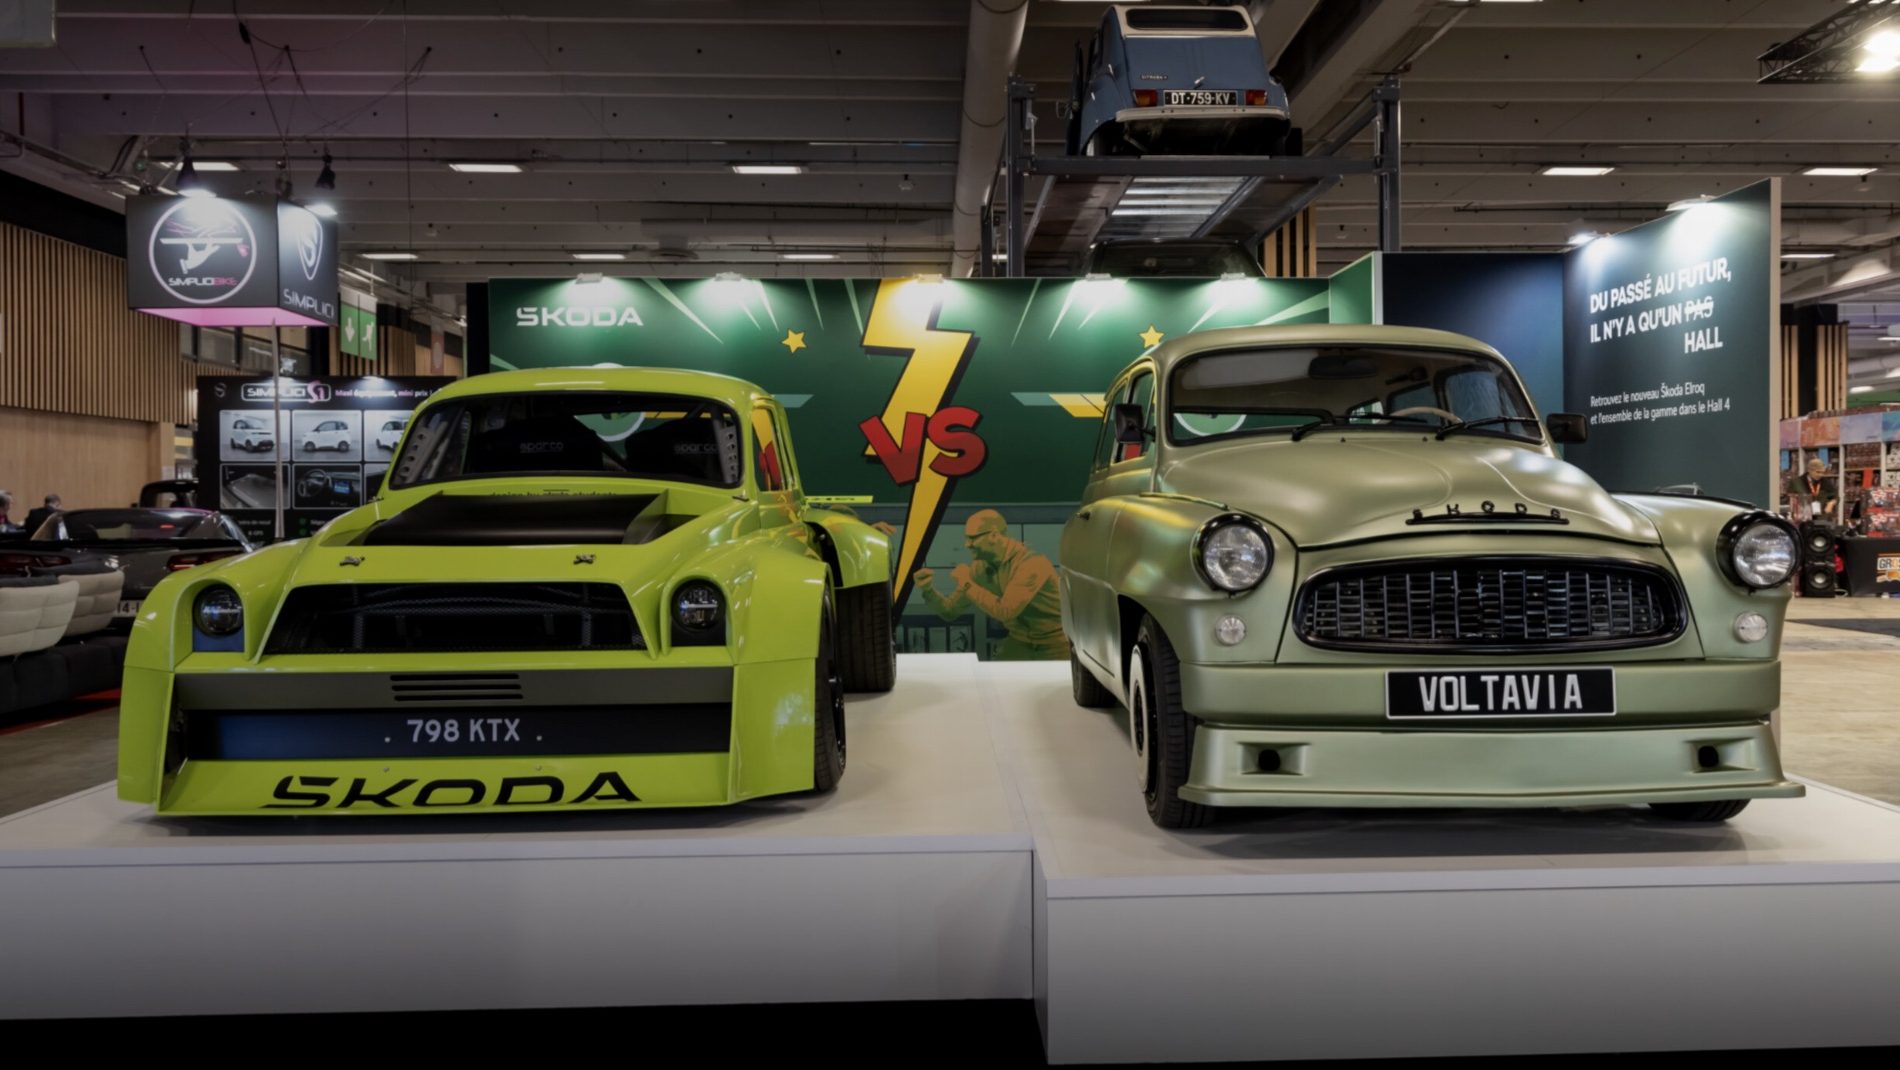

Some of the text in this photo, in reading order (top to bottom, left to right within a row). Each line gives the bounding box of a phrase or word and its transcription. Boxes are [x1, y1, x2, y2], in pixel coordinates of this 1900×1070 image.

[1590, 257, 1732, 314] DU PASSÉ AU FUTUR,
[283, 288, 335, 319] SIMPLICI
[1590, 296, 1714, 343] IL N'Y A QU'UN PAS
[1684, 326, 1723, 354] HALL
[1590, 395, 1622, 407] Retrouvez
[1622, 391, 1629, 403] le
[1630, 389, 1660, 402] nouveau
[1684, 381, 1705, 396] Elroq
[1590, 397, 1730, 425] et l'ensemble de la gamme dans le Hall 4
[859, 405, 988, 486] VS
[1880, 558, 1900, 569] GRO
[1418, 674, 1583, 711] VOLTAVIA
[407, 718, 521, 743] 798 KTX
